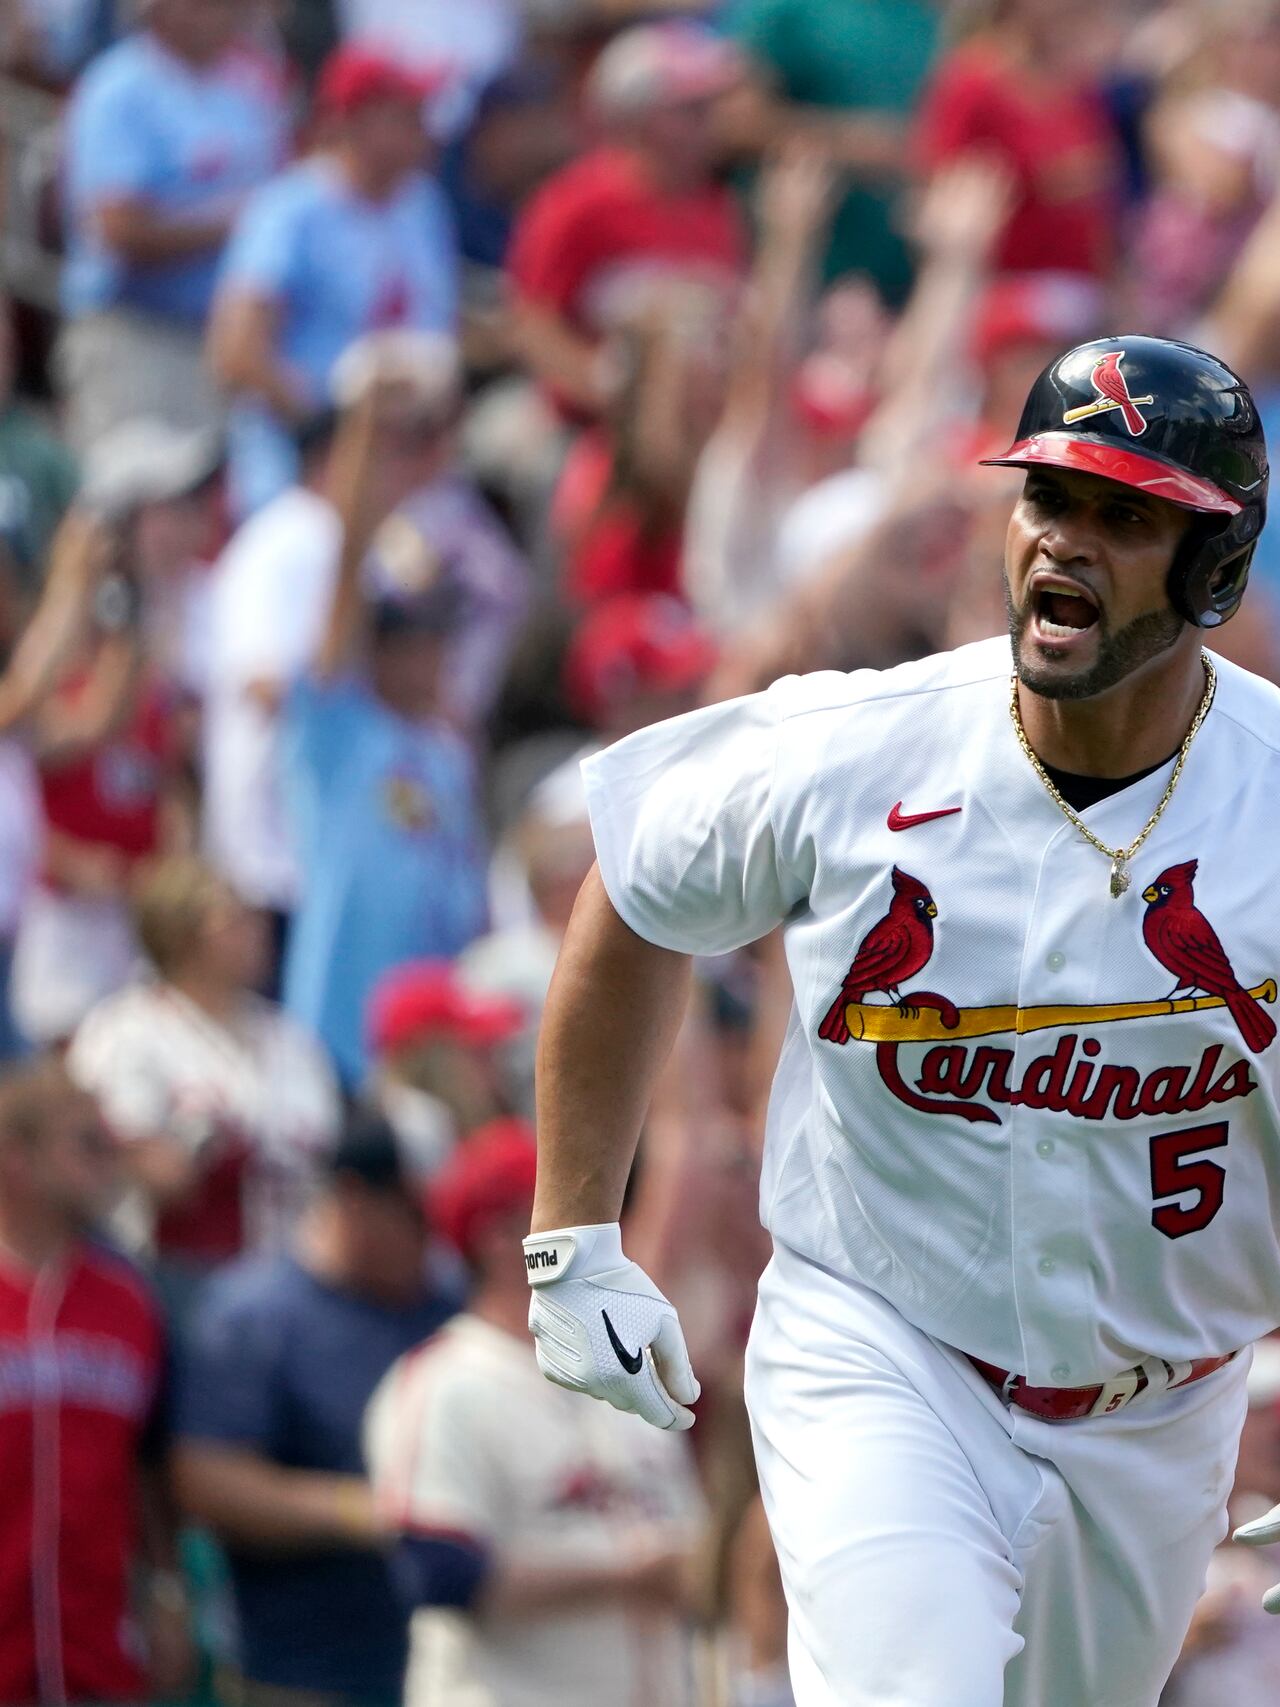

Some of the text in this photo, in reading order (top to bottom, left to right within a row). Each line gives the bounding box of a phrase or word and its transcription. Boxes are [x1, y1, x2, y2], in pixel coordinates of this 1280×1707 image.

[876, 992, 1258, 1125] Cardinals
[1149, 1120, 1229, 1240] 5
[1105, 1392, 1125, 1412] 5
